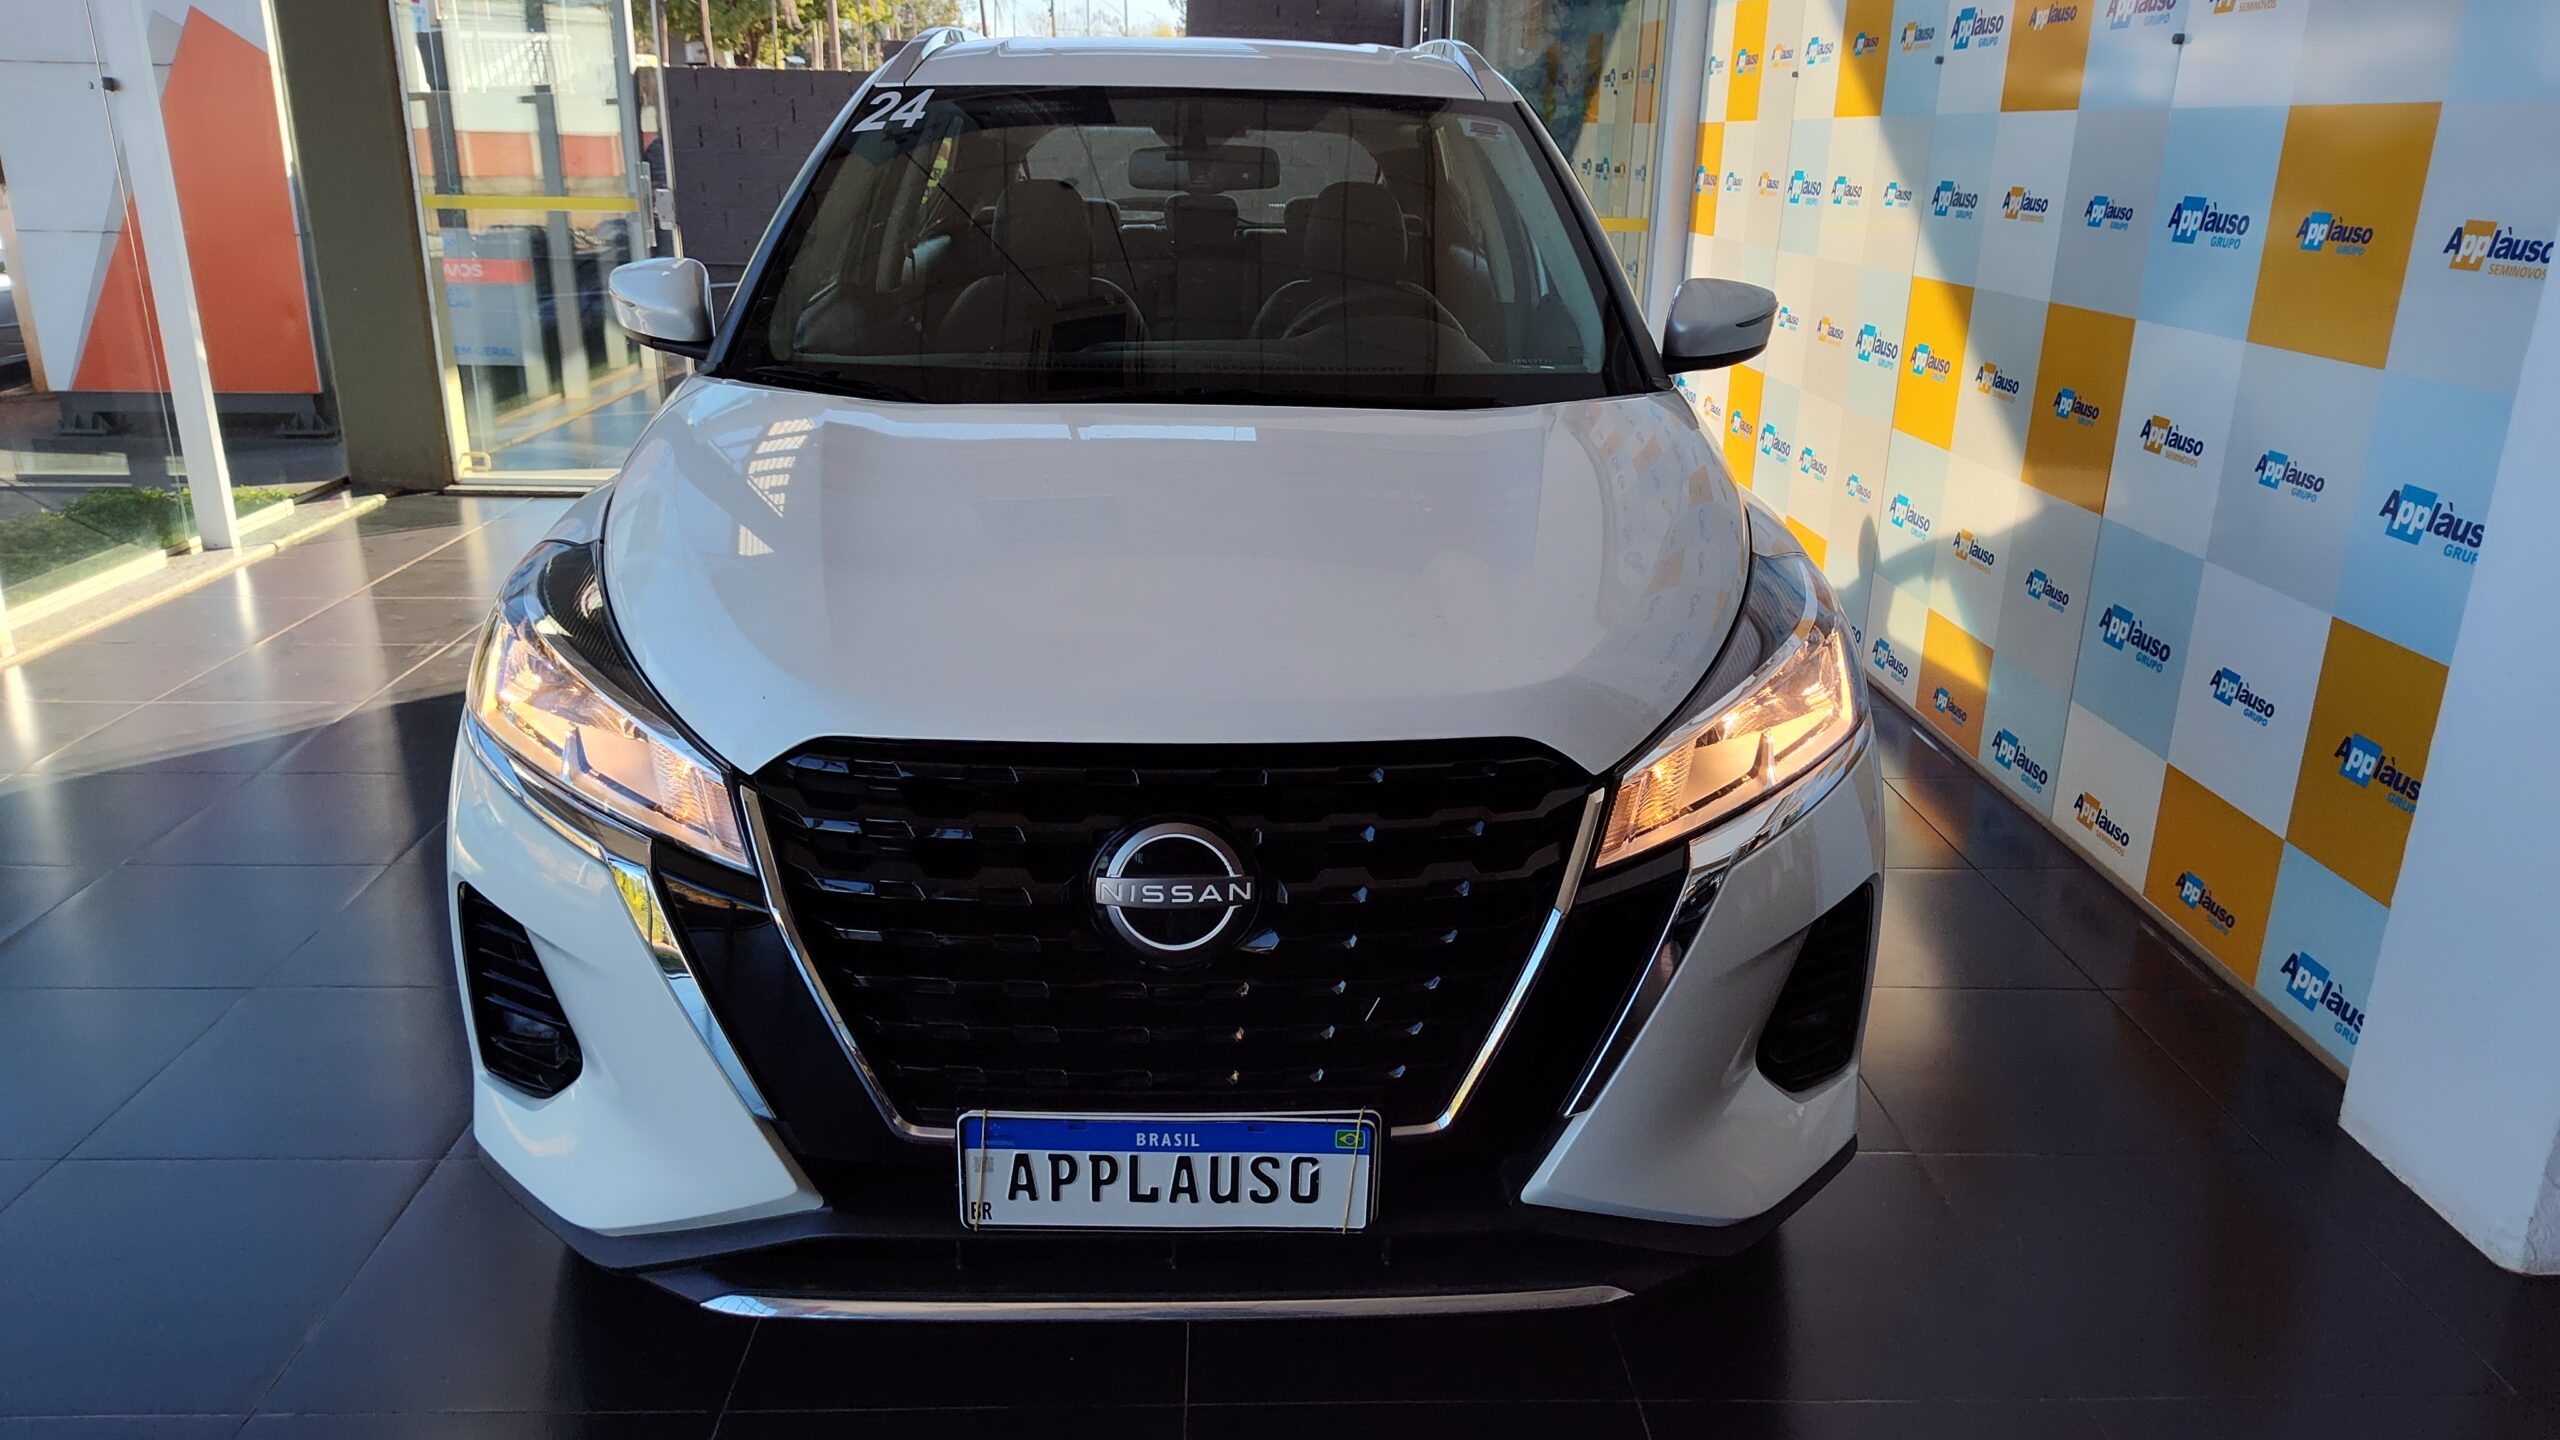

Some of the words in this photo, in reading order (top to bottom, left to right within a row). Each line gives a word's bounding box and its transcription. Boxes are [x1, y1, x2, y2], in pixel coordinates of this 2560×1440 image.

[852, 88, 935, 132] 24
[2210, 236, 2241, 250] GRUPO
[2488, 264, 2548, 281] SEMINOVOS
[2291, 488, 2318, 503] GRUPO
[2379, 489, 2485, 548] Applàus
[2136, 652, 2163, 673] GRUPO
[2243, 708, 2268, 727] GRUPO
[2334, 736, 2421, 801] Applàus
[1101, 882, 1252, 903] NISSAN
[2280, 953, 2366, 1034] Applàus
[2334, 1022, 2359, 1046] GRU
[1136, 1132, 1200, 1148] BRASIL
[1007, 1152, 1321, 1205] APPLAUSO
